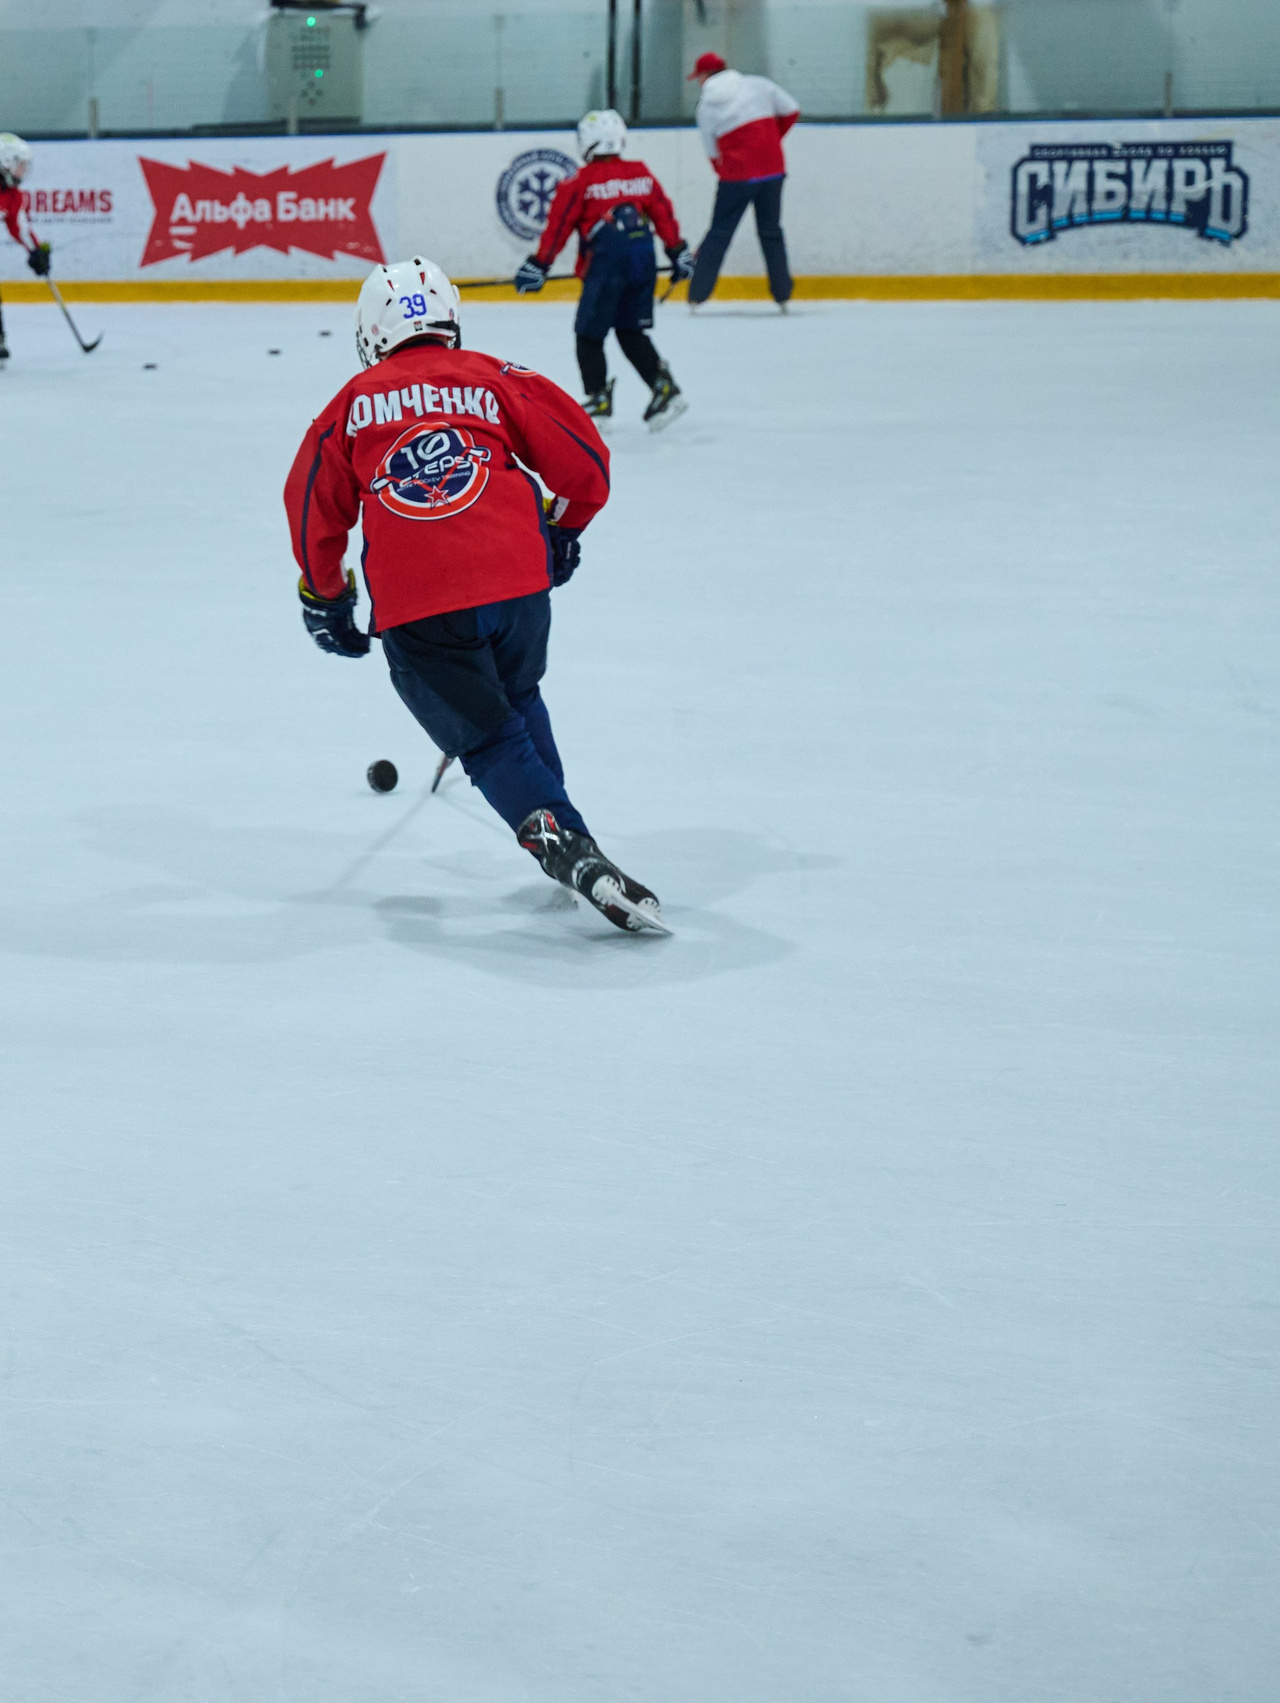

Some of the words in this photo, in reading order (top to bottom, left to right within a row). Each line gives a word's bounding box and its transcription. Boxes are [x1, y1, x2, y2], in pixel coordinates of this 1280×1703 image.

[170, 192, 272, 229] Альфа
[276, 191, 357, 222] Банк
[1015, 157, 1244, 242] СИБИРЬ
[399, 293, 427, 319] 39
[400, 432, 451, 470] 10
